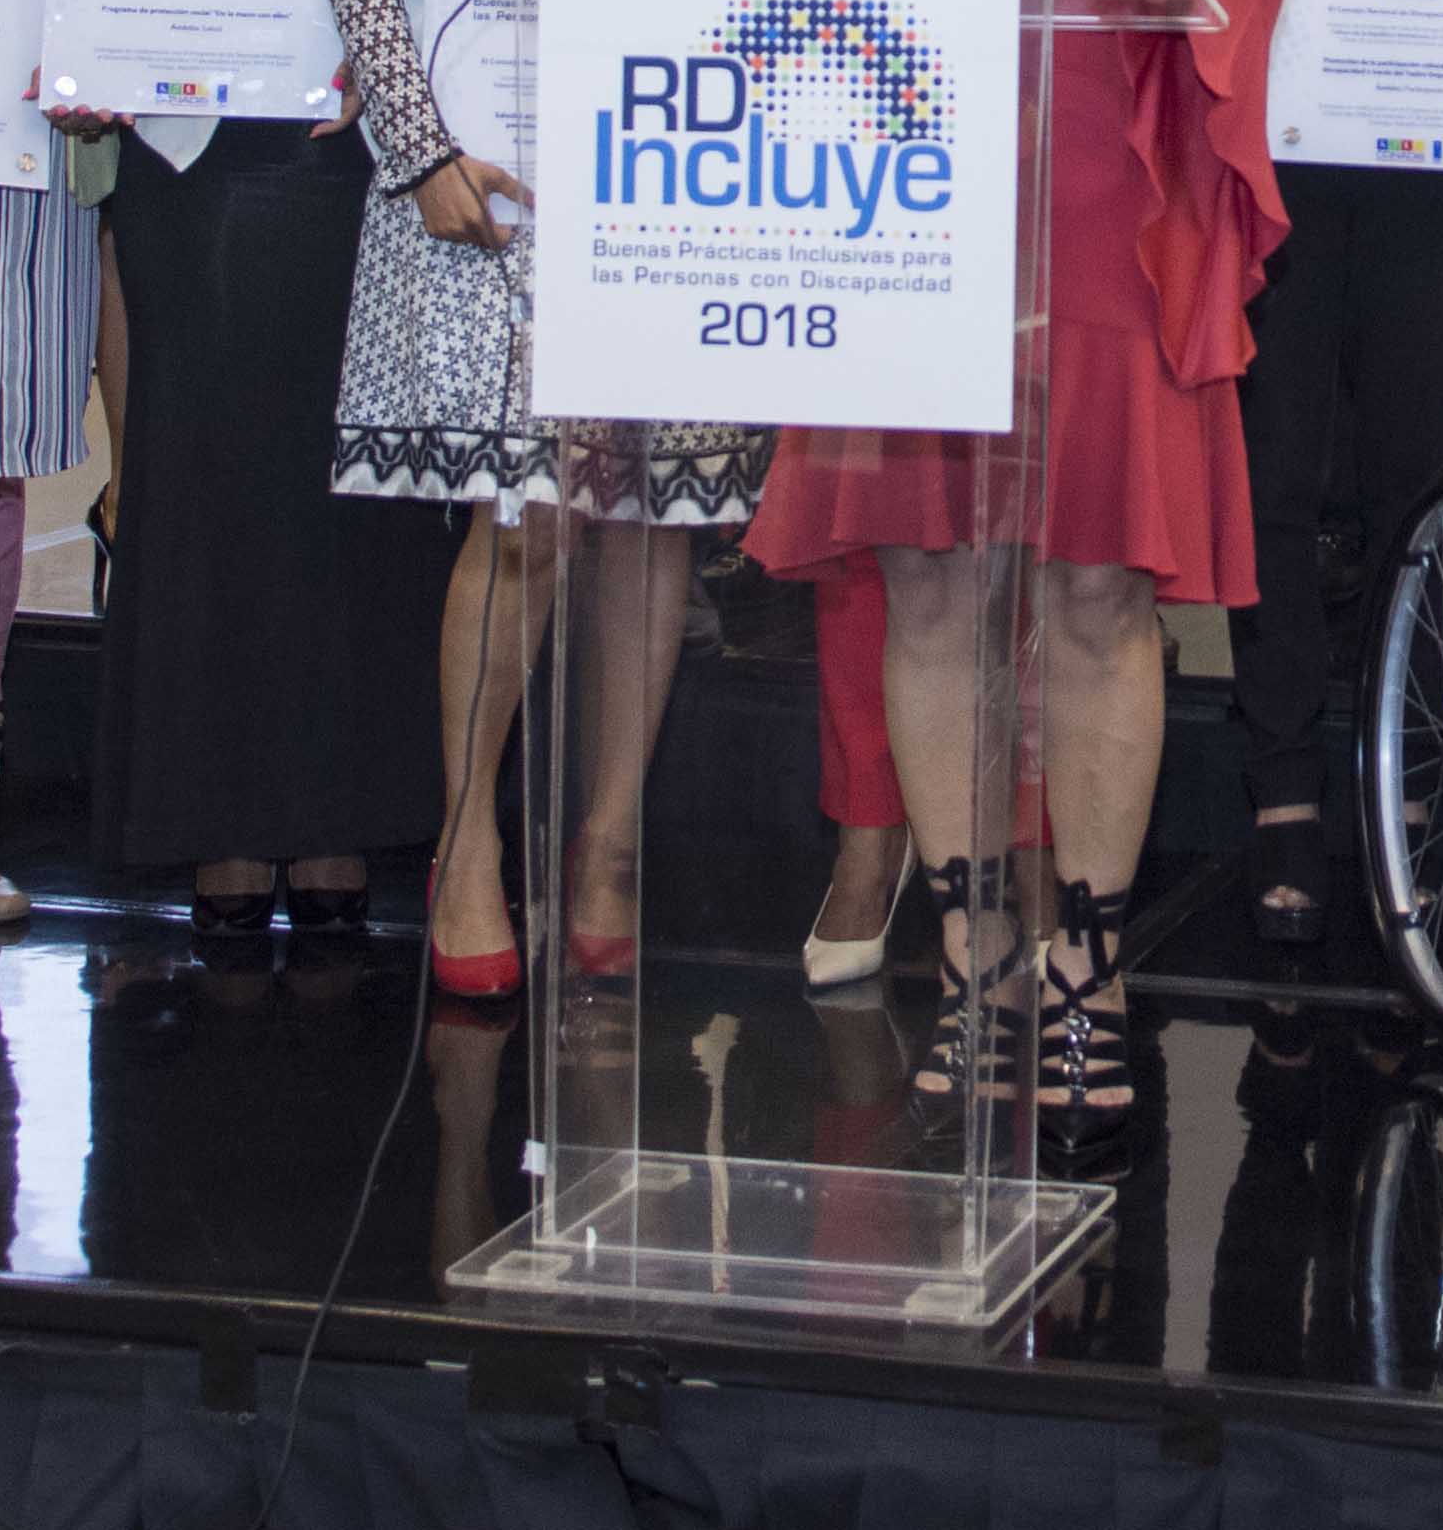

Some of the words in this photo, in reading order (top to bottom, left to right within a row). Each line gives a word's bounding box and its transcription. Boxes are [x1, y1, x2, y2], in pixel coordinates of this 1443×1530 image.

[622, 56, 747, 133] RD
[595, 108, 952, 238] Incluye
[594, 239, 671, 258] Buenas
[679, 241, 782, 261] Prácticas
[789, 244, 895, 265] Inclusivas
[902, 249, 952, 269] para
[593, 266, 623, 283] las
[635, 266, 739, 287] Personas
[750, 272, 789, 289] con
[801, 270, 952, 294] Discapacidad
[700, 301, 837, 348] 2018
